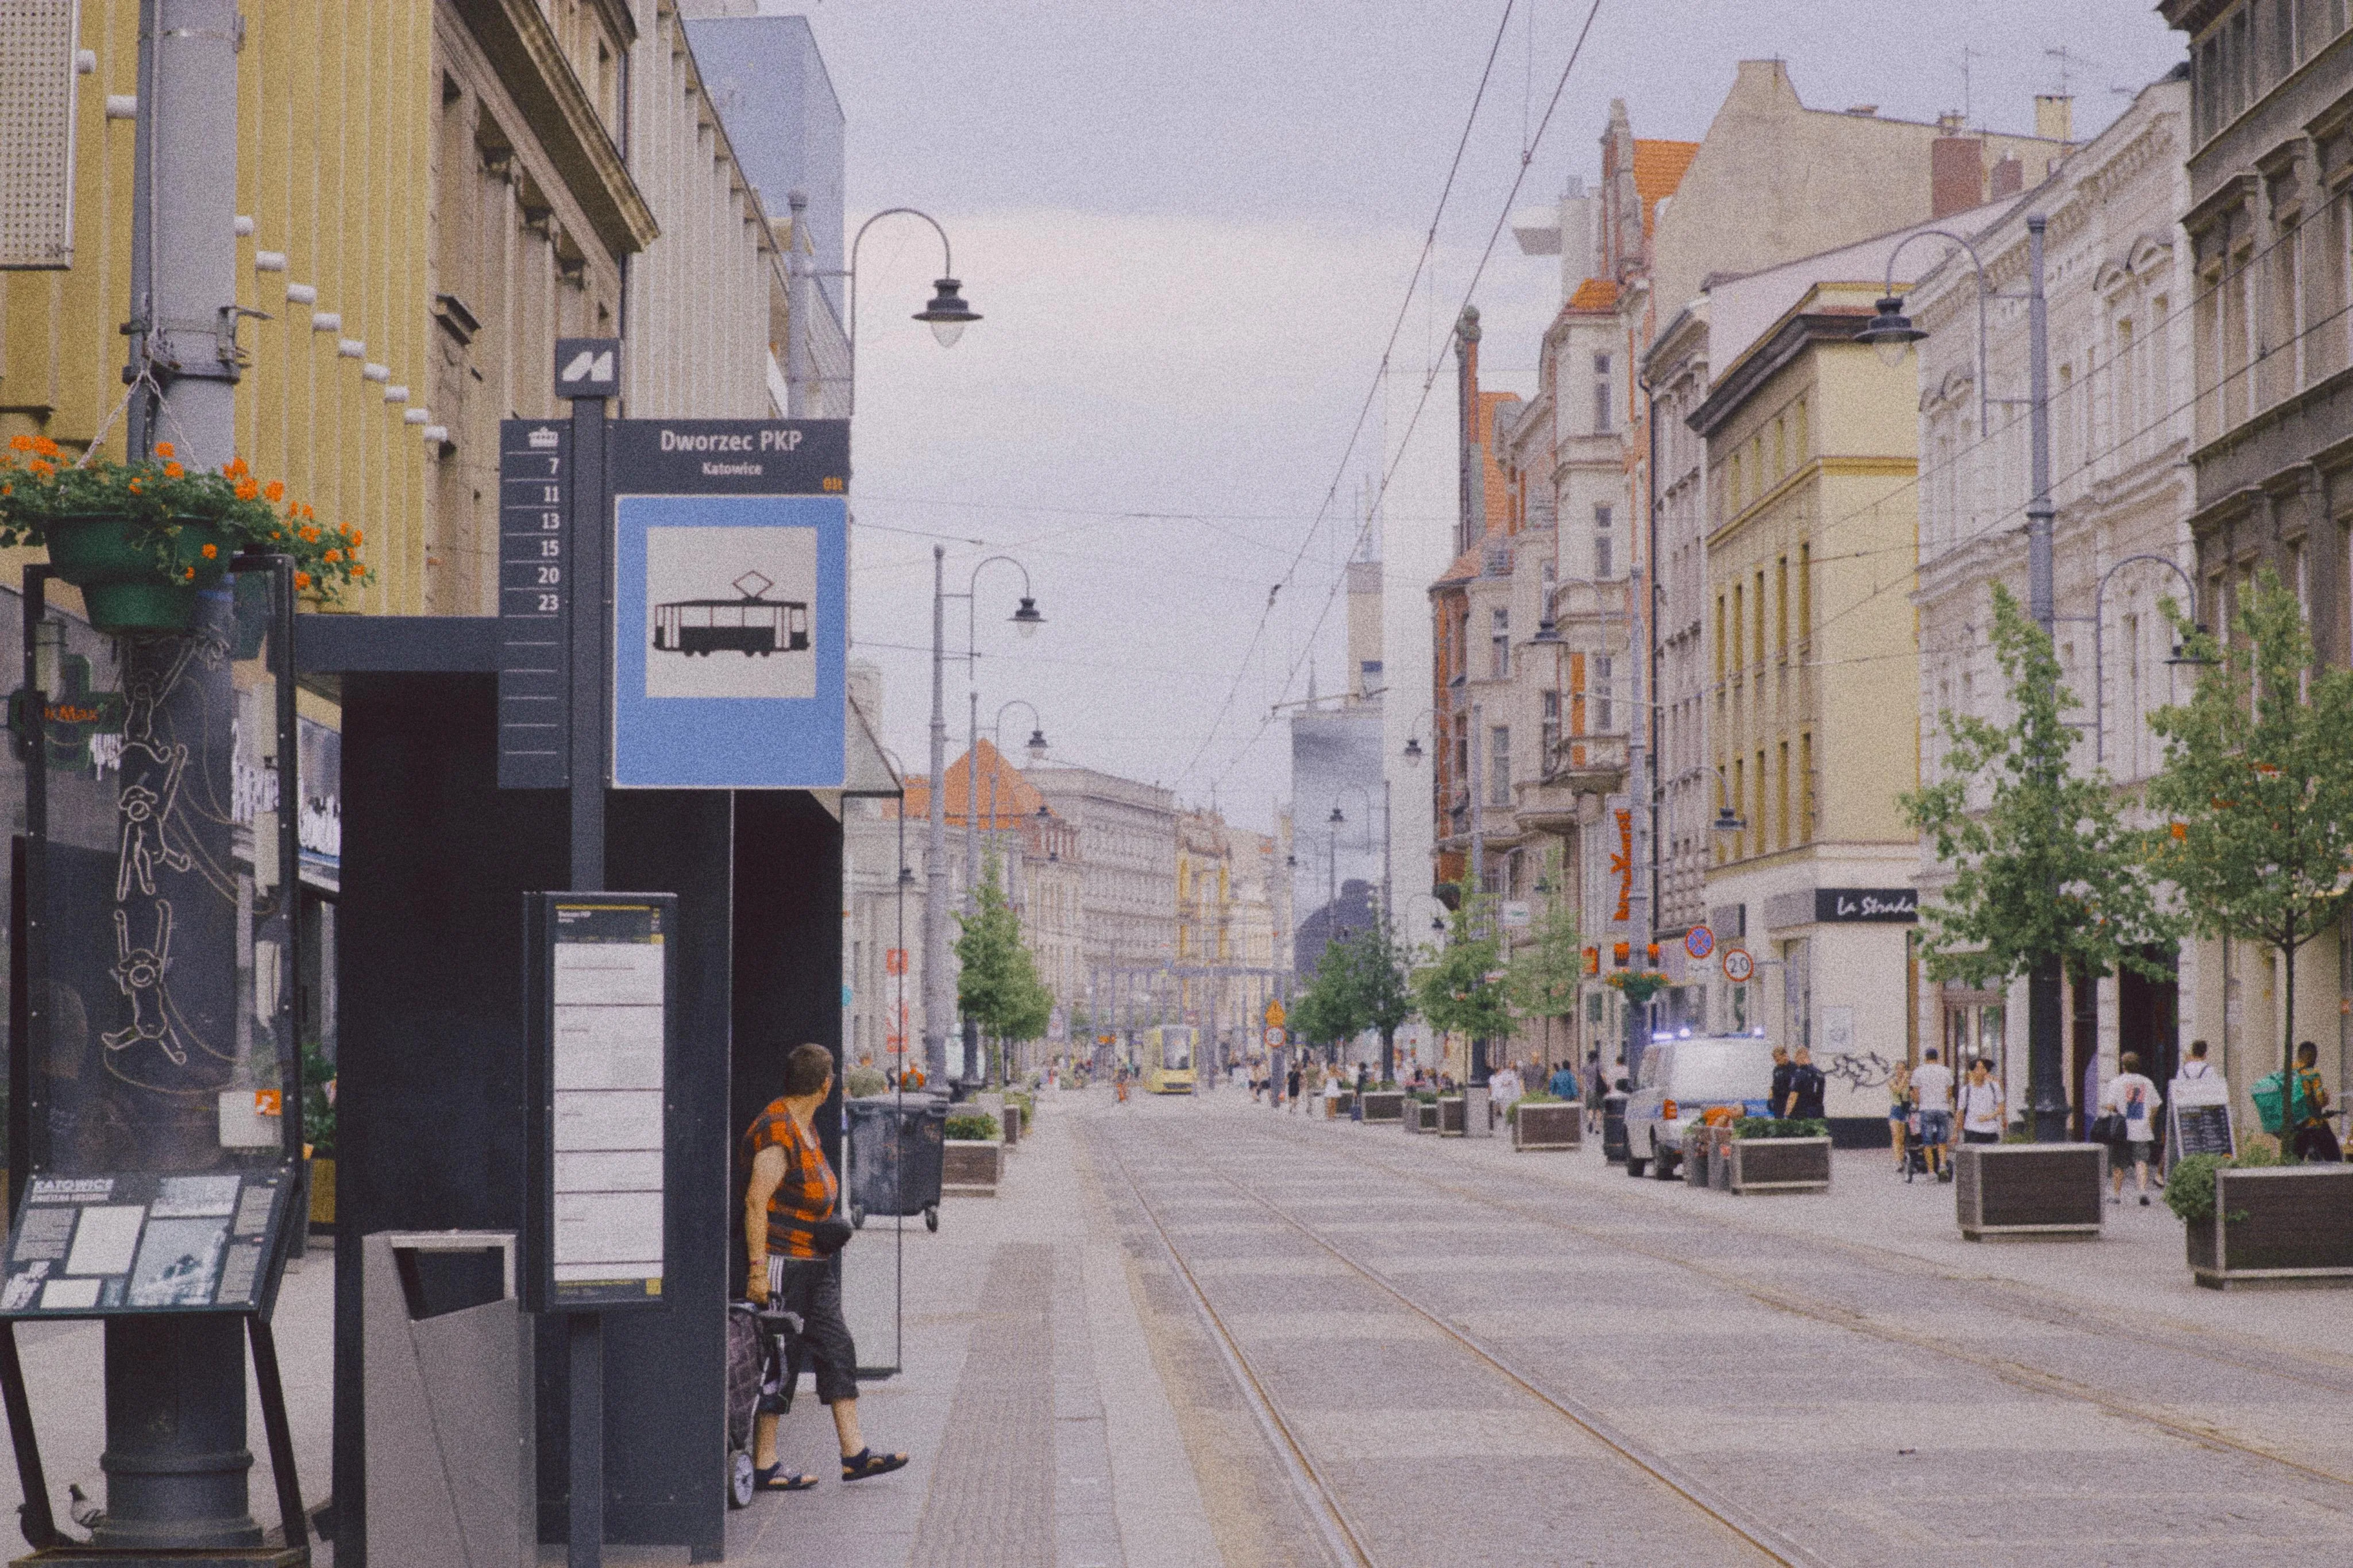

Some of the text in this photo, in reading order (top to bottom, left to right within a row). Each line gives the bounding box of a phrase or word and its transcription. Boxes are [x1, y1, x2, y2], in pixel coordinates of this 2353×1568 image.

[661, 430, 803, 451] Dworzec PKP
[549, 457, 559, 474] 7
[702, 462, 763, 475] Katowice
[544, 486, 559, 502] 11
[542, 512, 560, 529] 13
[542, 539, 559, 556] 15
[538, 567, 560, 584] 20
[538, 594, 559, 611] 23
[1837, 896, 1915, 916] La Strada
[1728, 957, 1749, 972] 20
